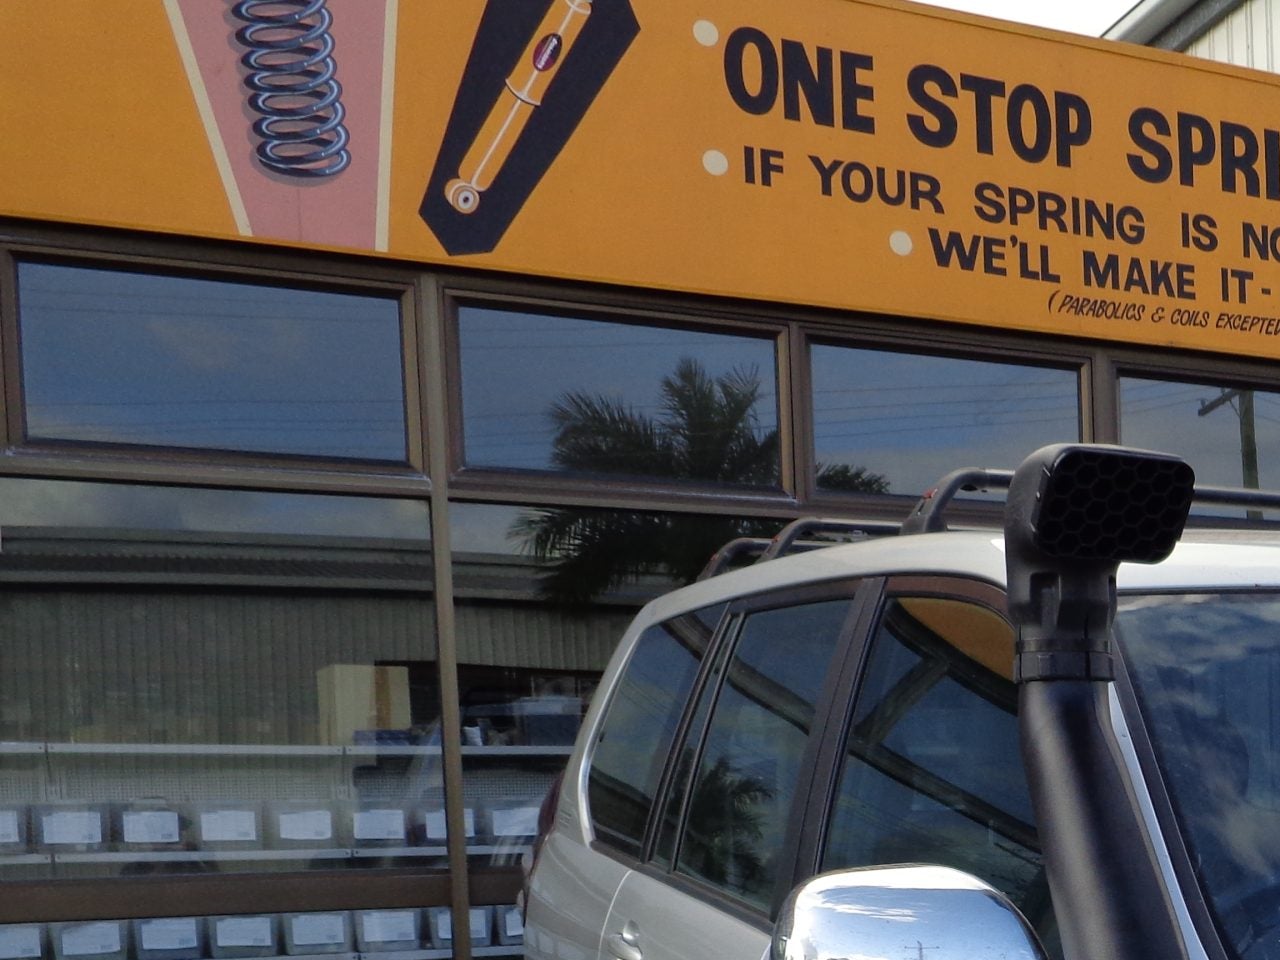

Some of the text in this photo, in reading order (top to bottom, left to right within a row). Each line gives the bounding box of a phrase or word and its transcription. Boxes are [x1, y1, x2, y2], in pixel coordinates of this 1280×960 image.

[724, 26, 876, 136] ONE
[905, 63, 1093, 168] STOP
[743, 145, 784, 188] IF
[808, 154, 945, 215] YOUR
[974, 182, 1146, 245] SPRING
[1181, 212, 1219, 253] IS
[928, 228, 1061, 284] WE'LL
[1083, 250, 1197, 301] MAKE
[1151, 307, 1165, 323] &
[1170, 308, 1210, 328] COILS
